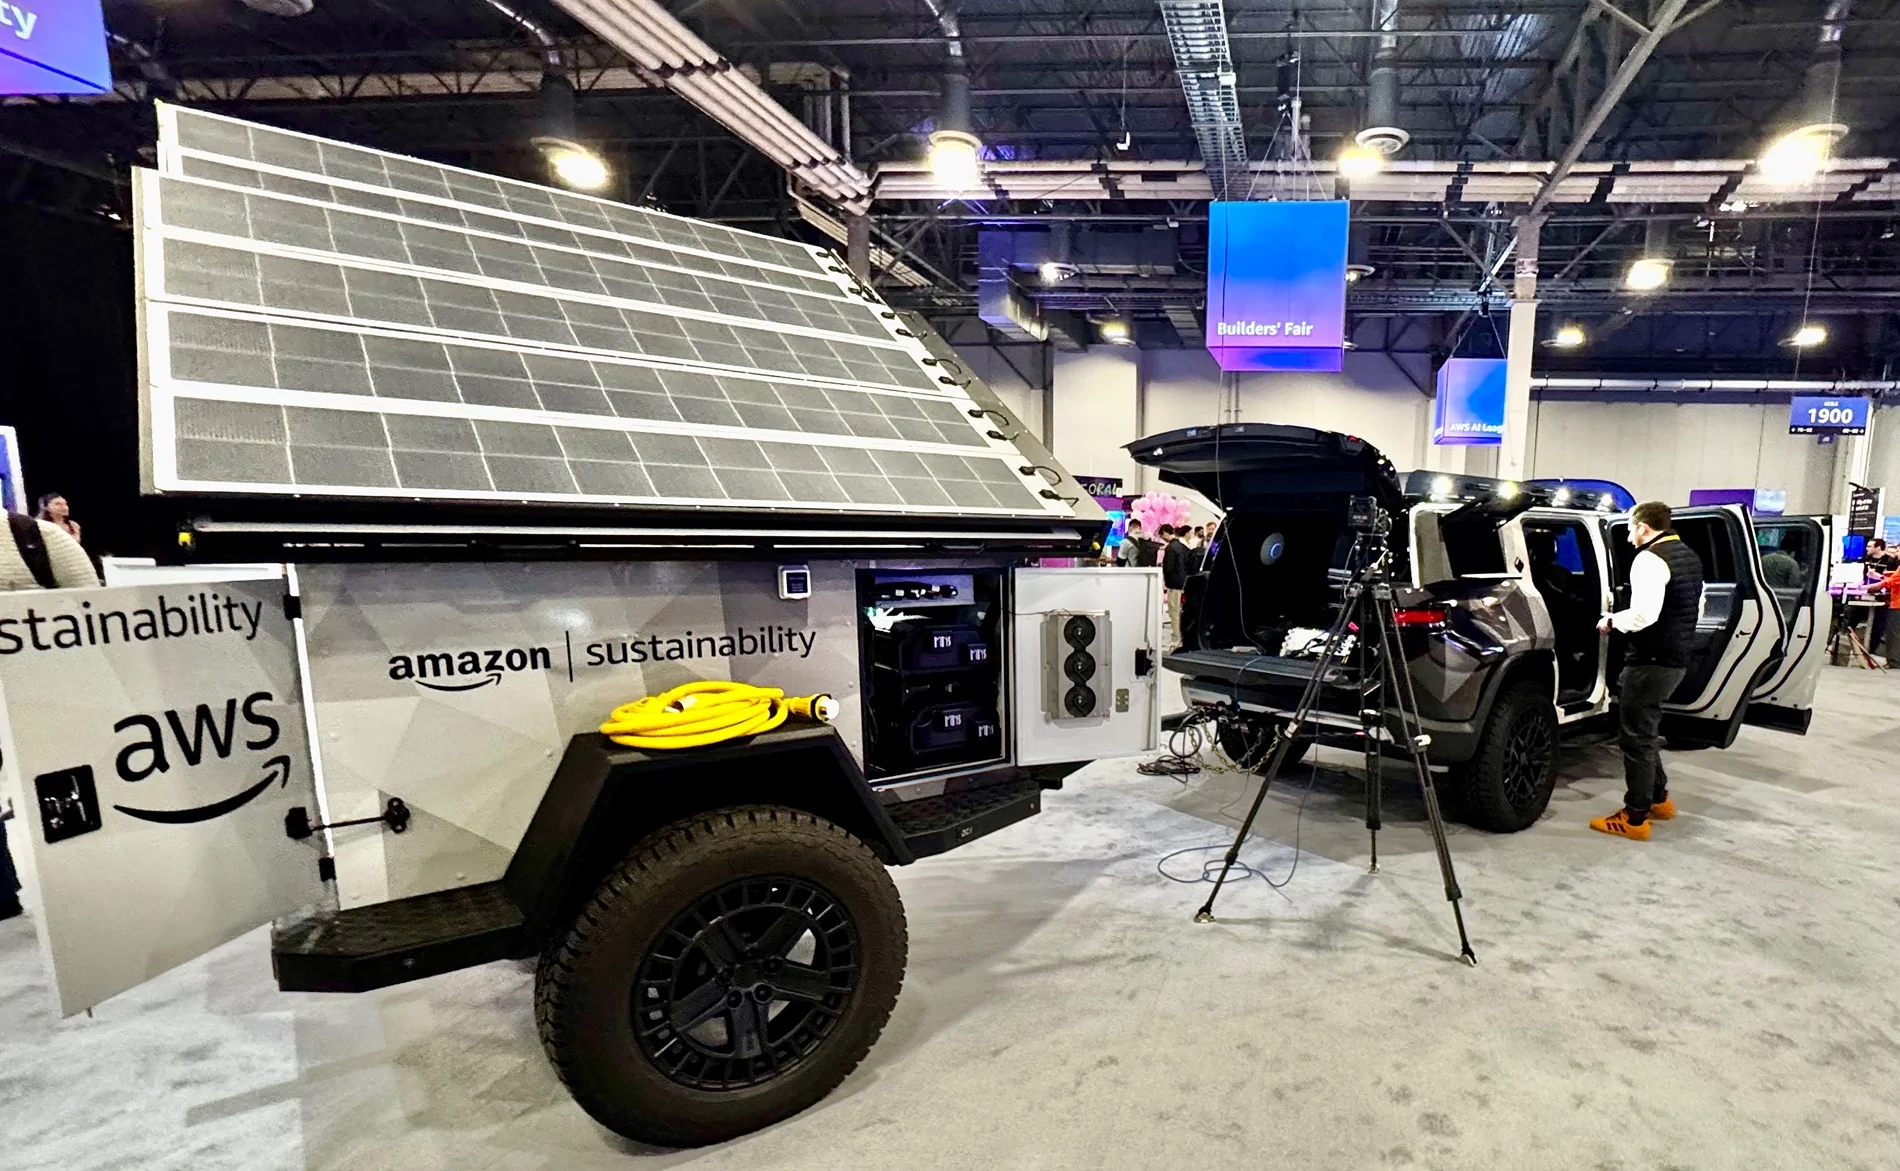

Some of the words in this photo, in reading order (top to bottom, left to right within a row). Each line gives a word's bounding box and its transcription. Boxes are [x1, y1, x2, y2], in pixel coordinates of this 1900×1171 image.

[1217, 321, 1282, 336] Builders'
[1284, 321, 1314, 336] Fair
[1808, 408, 1853, 424] 1900
[1450, 423, 1470, 432] AWS
[1471, 423, 1481, 432] AI
[1082, 483, 1118, 496] ORAL
[0, 593, 262, 655] stainability
[388, 645, 551, 681] amazon
[587, 626, 816, 666] sustainability
[114, 692, 280, 782] aws
